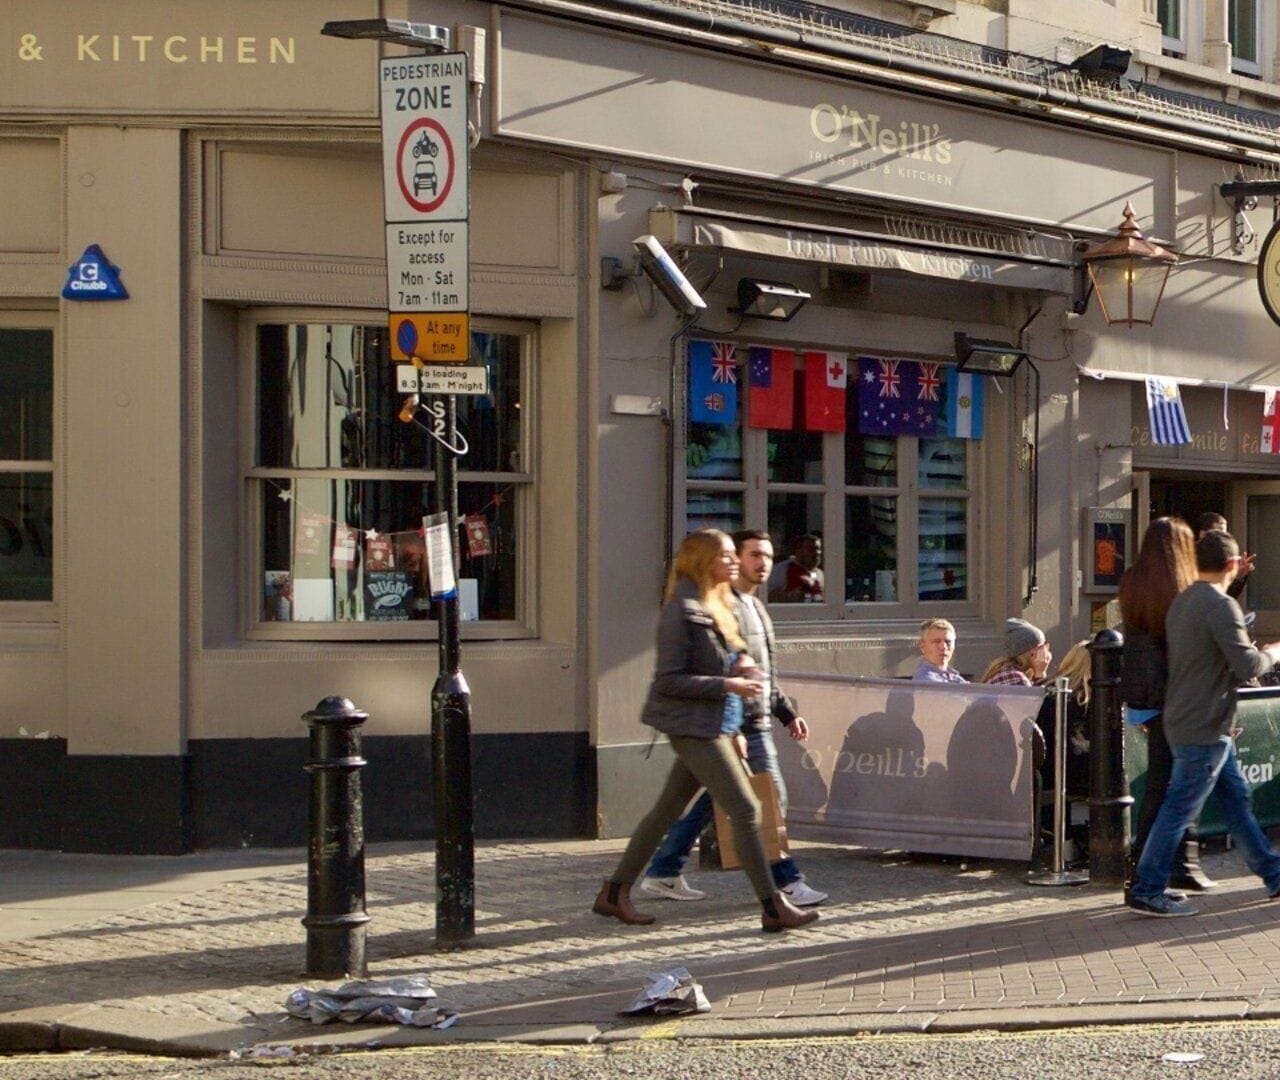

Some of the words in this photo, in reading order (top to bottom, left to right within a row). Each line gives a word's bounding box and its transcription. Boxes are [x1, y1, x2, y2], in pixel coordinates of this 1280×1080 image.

[18, 33, 44, 61] &
[77, 34, 296, 64] KITCHEN
[383, 62, 463, 81] PEDESTRIAN
[395, 85, 452, 111] ZONE
[810, 103, 952, 165] O'Neill's
[810, 150, 846, 167] IRISH
[852, 159, 877, 171] PUB
[883, 165, 891, 175] &
[898, 167, 952, 185] KITCHEN
[398, 230, 435, 246] Except
[439, 229, 455, 244] for
[409, 252, 445, 265] access
[786, 231, 837, 261] Irish
[849, 239, 888, 265] Pub
[919, 250, 992, 280] Kitchen
[71, 281, 108, 290] Chubb
[401, 271, 424, 286] Mon
[435, 270, 454, 286] Sat
[398, 291, 421, 305] 7am
[432, 290, 458, 305] 11am
[427, 321, 439, 334] At
[442, 323, 461, 337] any
[432, 342, 456, 354] time
[433, 370, 467, 379] loading
[426, 380, 440, 388] am
[367, 580, 413, 598] RUGBY
